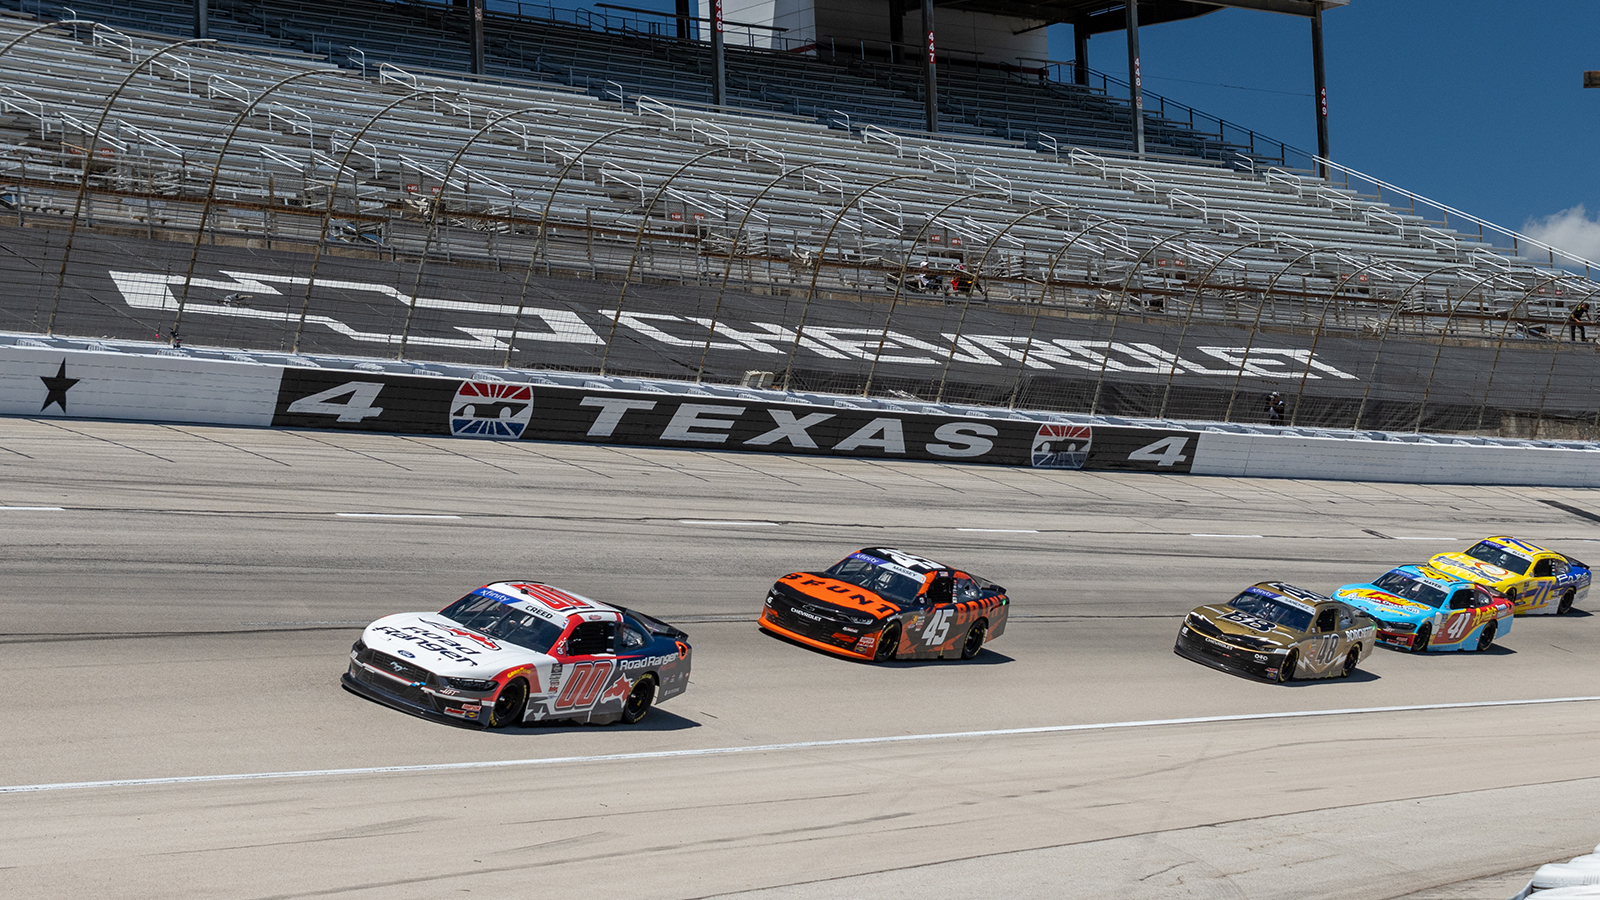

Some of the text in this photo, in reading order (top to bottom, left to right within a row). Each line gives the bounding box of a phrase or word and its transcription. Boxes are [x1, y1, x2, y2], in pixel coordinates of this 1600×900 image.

[597, 309, 1360, 381] CHEVROLET
[286, 381, 1189, 467] 4 TEXAS 4
[854, 553, 880, 564] xfinity
[480, 588, 511, 601] xfinity
[1423, 579, 1443, 589] MAYER
[1530, 579, 1553, 606] 71
[525, 605, 554, 620] CREED
[790, 607, 823, 622] CHEVROLET
[921, 609, 955, 646] 45
[1446, 613, 1472, 640] 41
[620, 657, 648, 671] Road
[647, 652, 679, 666] Ranger
[1315, 633, 1340, 665] 48
[555, 660, 612, 709] 00
